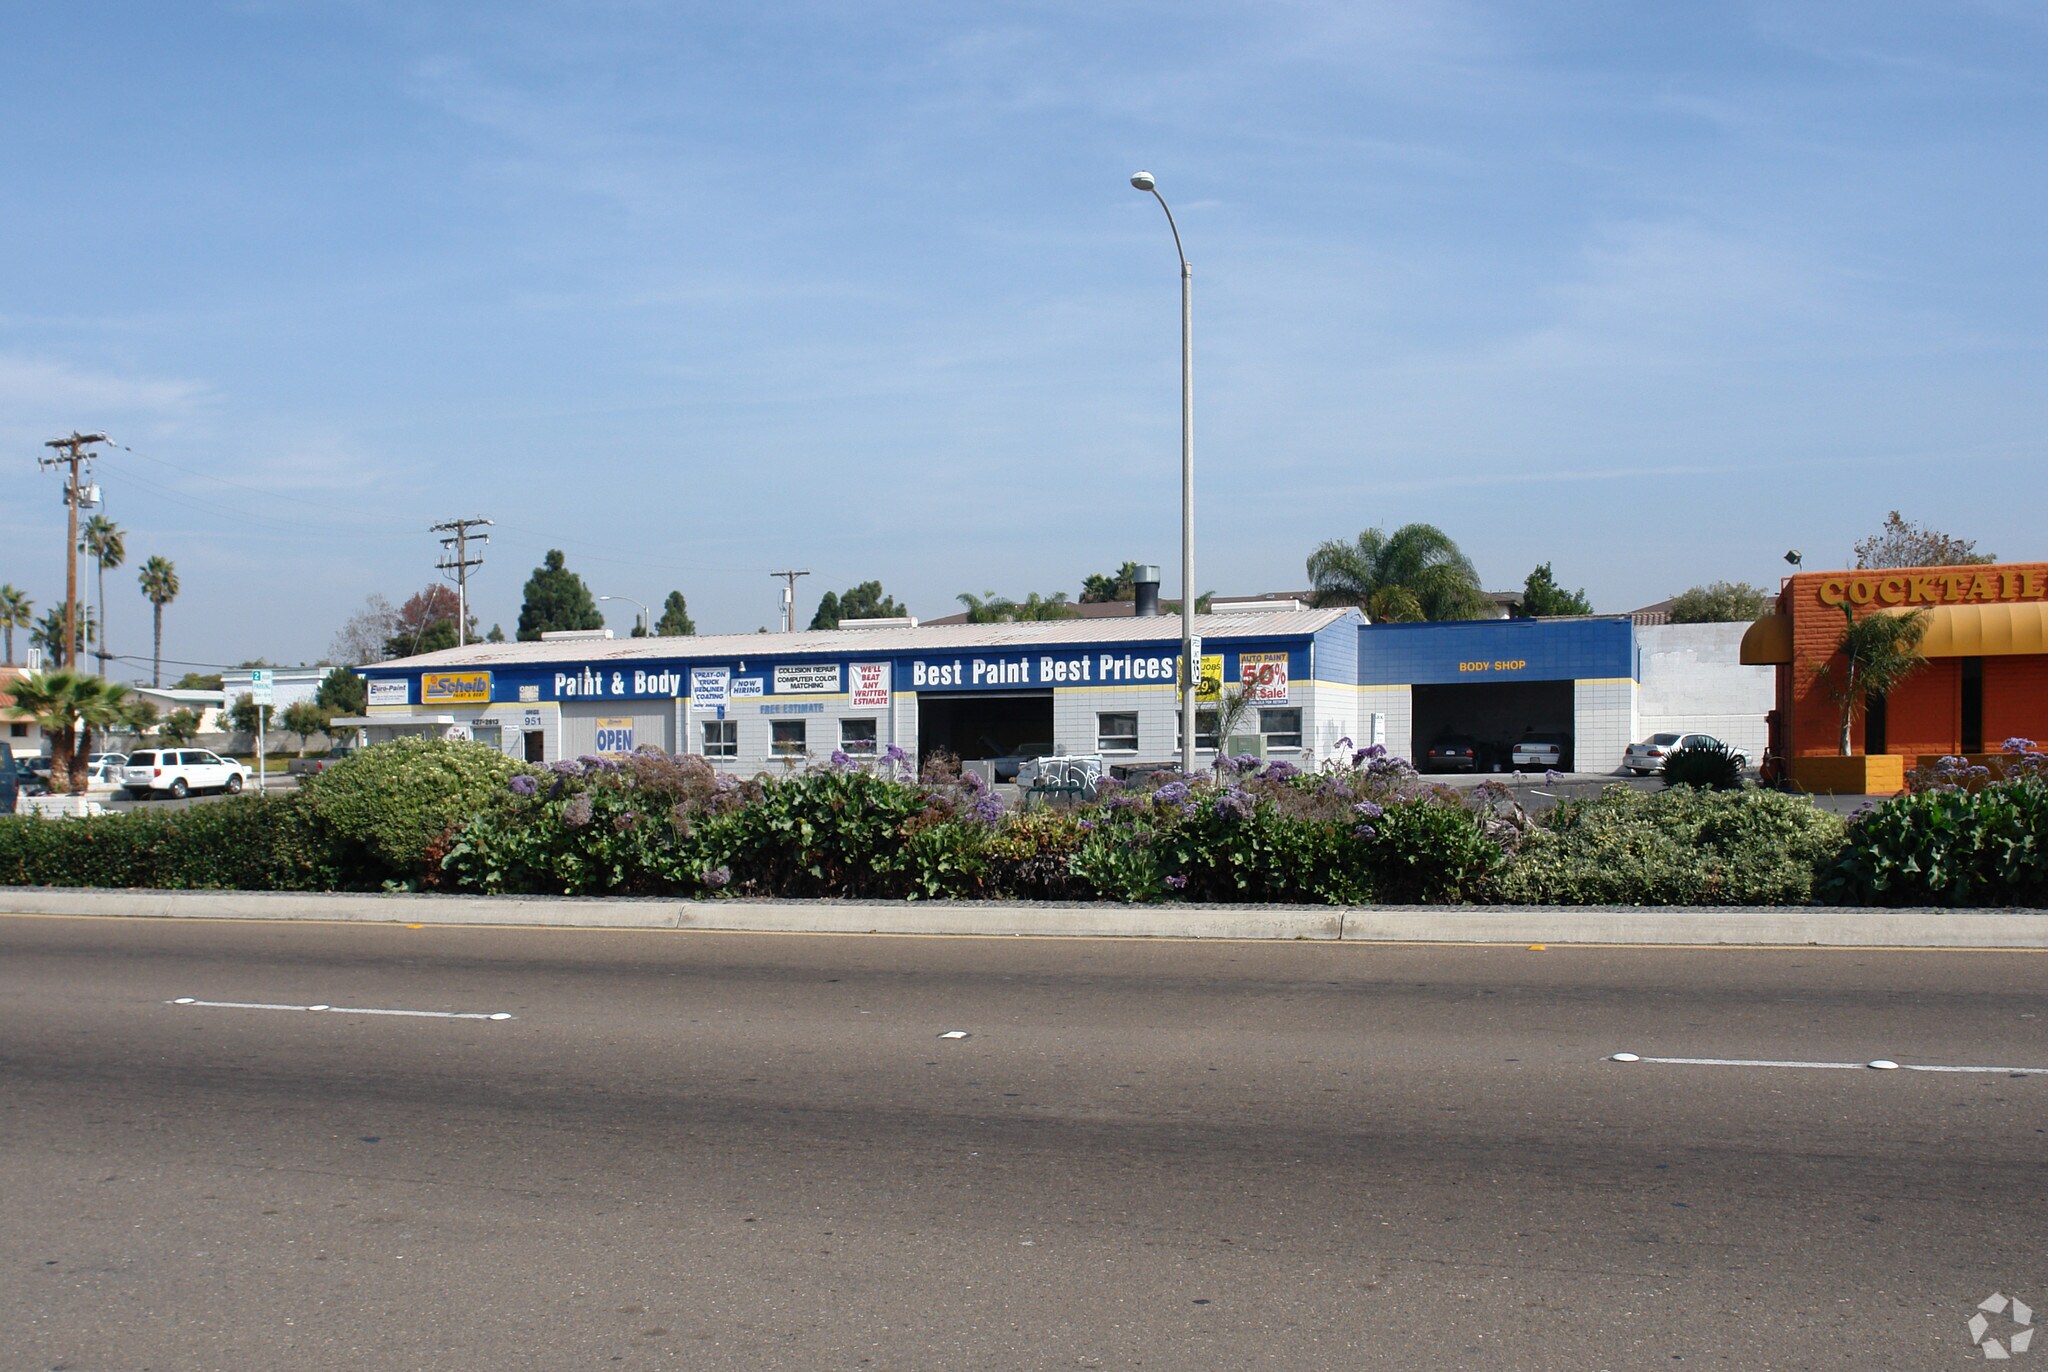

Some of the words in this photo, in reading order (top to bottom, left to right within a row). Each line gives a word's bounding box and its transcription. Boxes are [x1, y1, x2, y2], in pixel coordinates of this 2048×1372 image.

[1242, 654, 1262, 662] AUTO
[1264, 653, 1286, 661] PAINT
[860, 665, 881, 673] WE'LL
[913, 659, 962, 686] Best
[972, 657, 1030, 684] Paint
[1040, 655, 1091, 682] Best
[1099, 654, 1173, 680] Prices
[1201, 663, 1221, 671] JOBS
[1459, 661, 1490, 672] BODY
[1494, 660, 1526, 671] SHOP
[254, 672, 260, 680] 2
[777, 675, 813, 683] COMPUTER
[1243, 663, 1286, 686] 50%
[438, 677, 487, 693] Scheib
[555, 671, 603, 696] Paint
[611, 671, 625, 695] &
[634, 669, 681, 697] Body
[370, 684, 406, 695] Euro-Paint
[1260, 687, 1286, 699] Sale!
[760, 704, 781, 715] FREE
[783, 703, 824, 714] ESTIMATE
[525, 717, 542, 726] 951
[597, 729, 632, 751] OPEN
